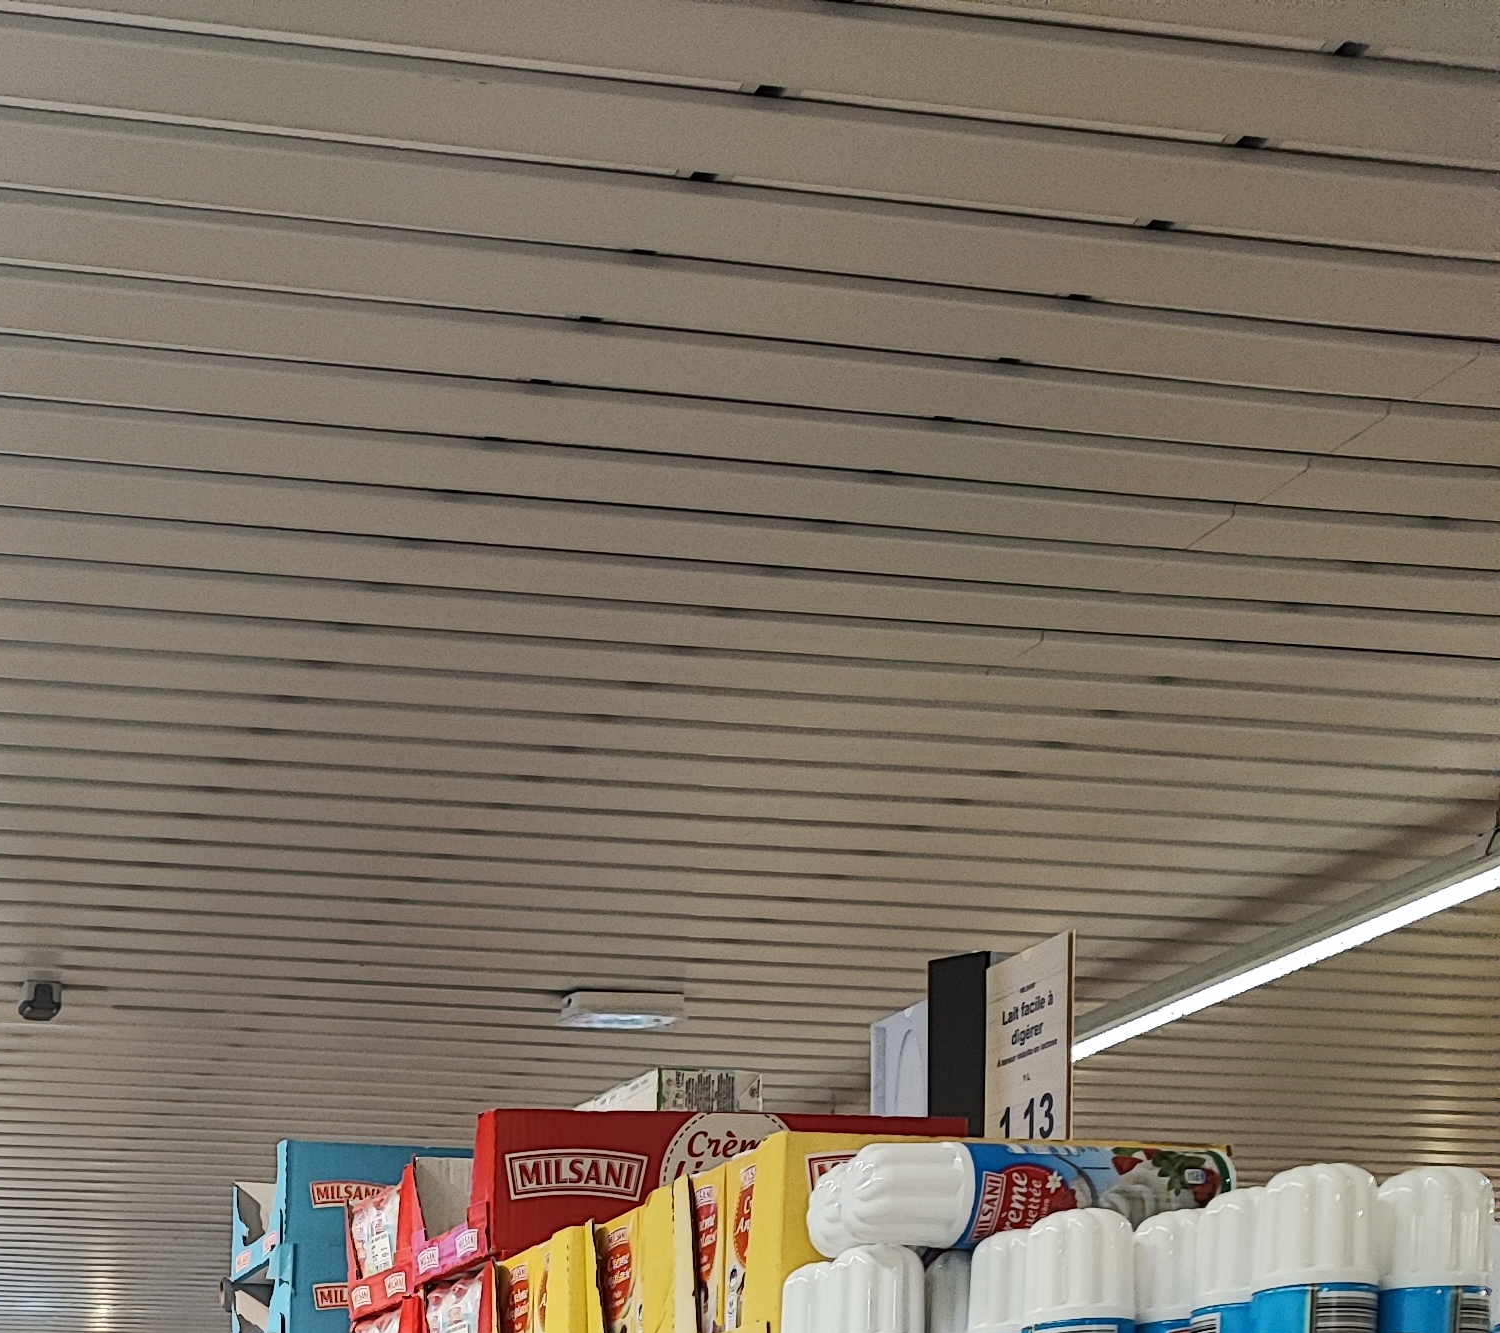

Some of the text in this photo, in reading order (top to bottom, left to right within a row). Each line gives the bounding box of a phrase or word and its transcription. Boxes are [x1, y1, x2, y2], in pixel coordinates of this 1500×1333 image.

[1002, 1007, 1019, 1025] Lait
[1021, 996, 1046, 1017] facile
[1011, 1021, 1044, 1046] digérer
[519, 1158, 636, 1190] MILSANI
